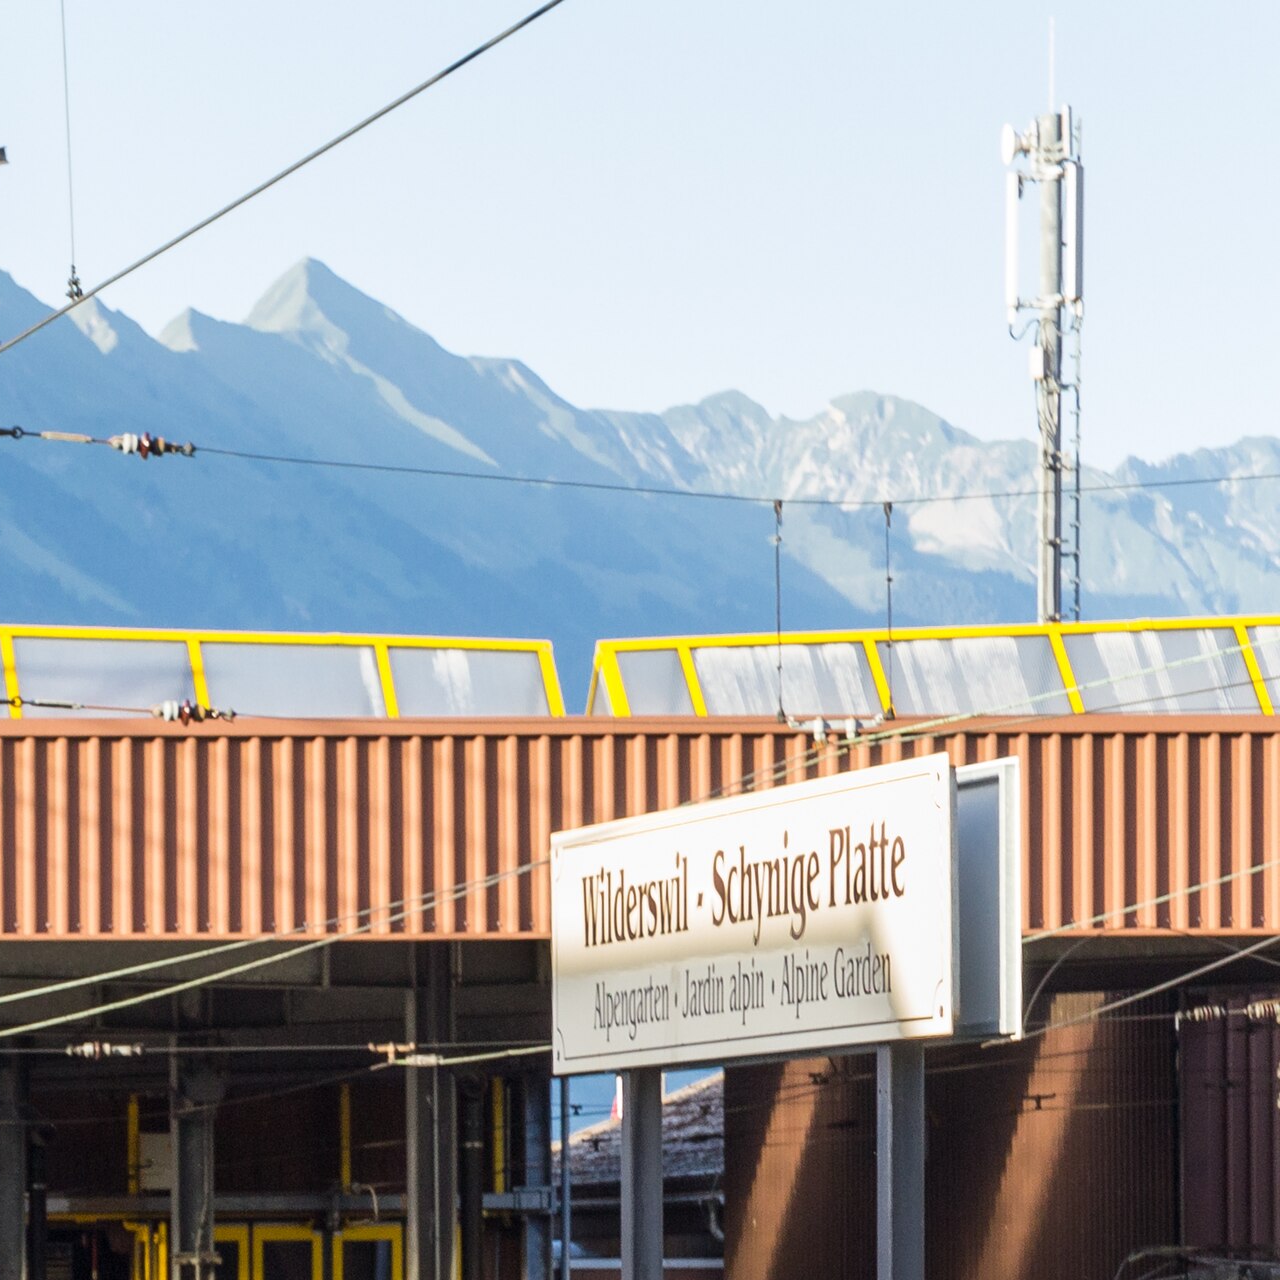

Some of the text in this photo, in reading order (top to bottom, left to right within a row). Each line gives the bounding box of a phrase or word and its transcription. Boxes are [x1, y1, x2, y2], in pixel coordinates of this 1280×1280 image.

[582, 852, 689, 948] Wilderswil
[712, 830, 820, 946] Schynige
[828, 820, 906, 908] Platte
[593, 975, 670, 1042] Alpengarten
[682, 963, 725, 1018] Jardin
[729, 957, 765, 1026] alpin
[780, 949, 828, 1019] Alpine
[833, 942, 892, 998] Garden
